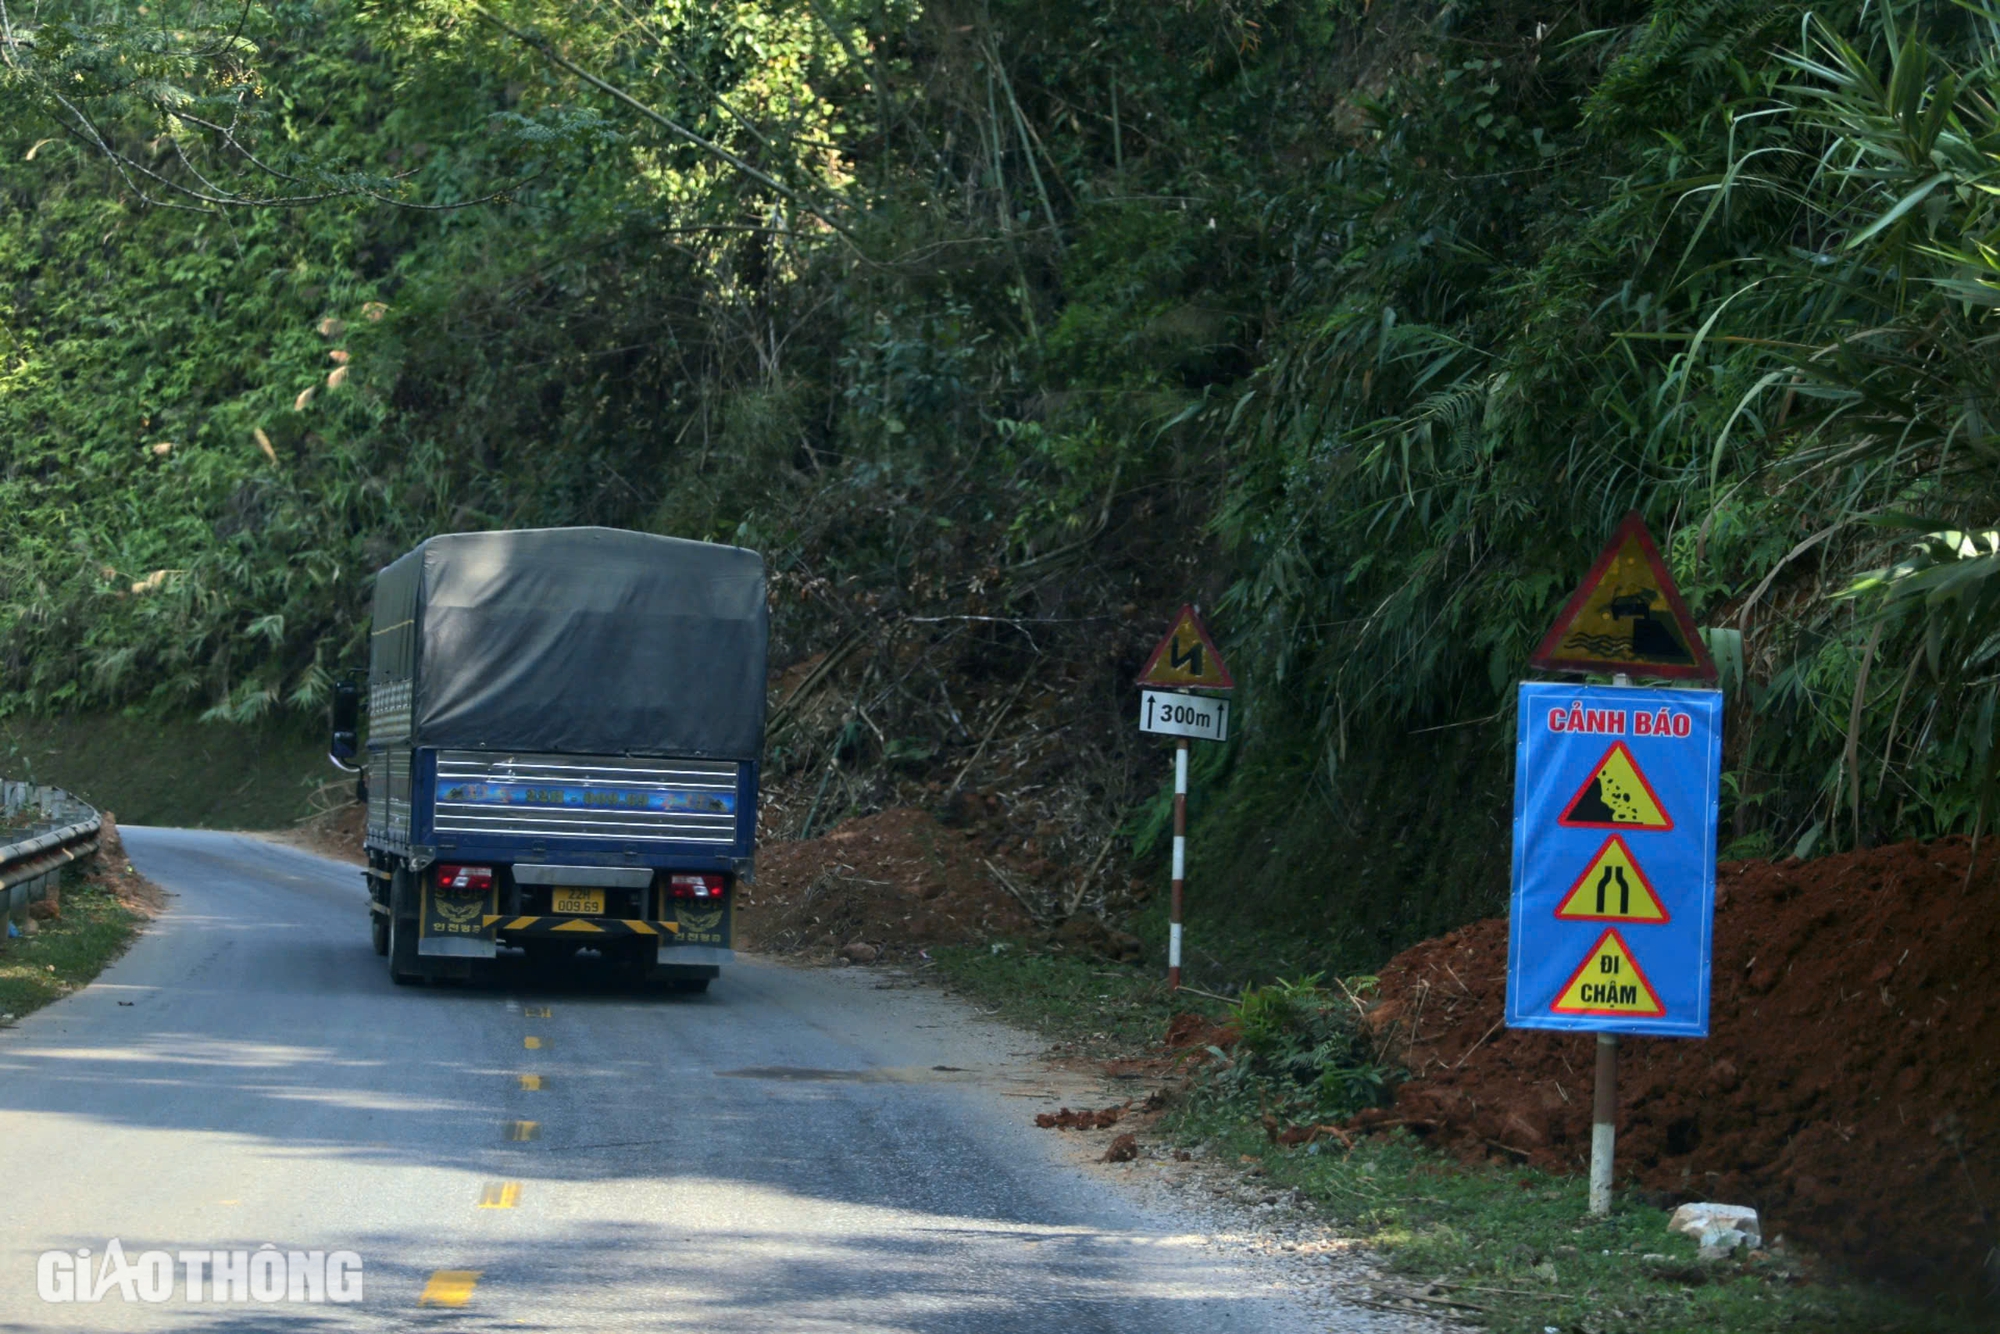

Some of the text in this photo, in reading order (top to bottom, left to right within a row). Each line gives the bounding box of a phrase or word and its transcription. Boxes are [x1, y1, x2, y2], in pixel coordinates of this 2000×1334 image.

[1160, 704, 1211, 728] 300m
[1548, 701, 1692, 738] CẢNH BÁO
[568, 887, 591, 900] 22H
[557, 900, 600, 913] 009.69
[1600, 954, 1620, 975] ĐI
[1580, 980, 1637, 1008] CHẬM
